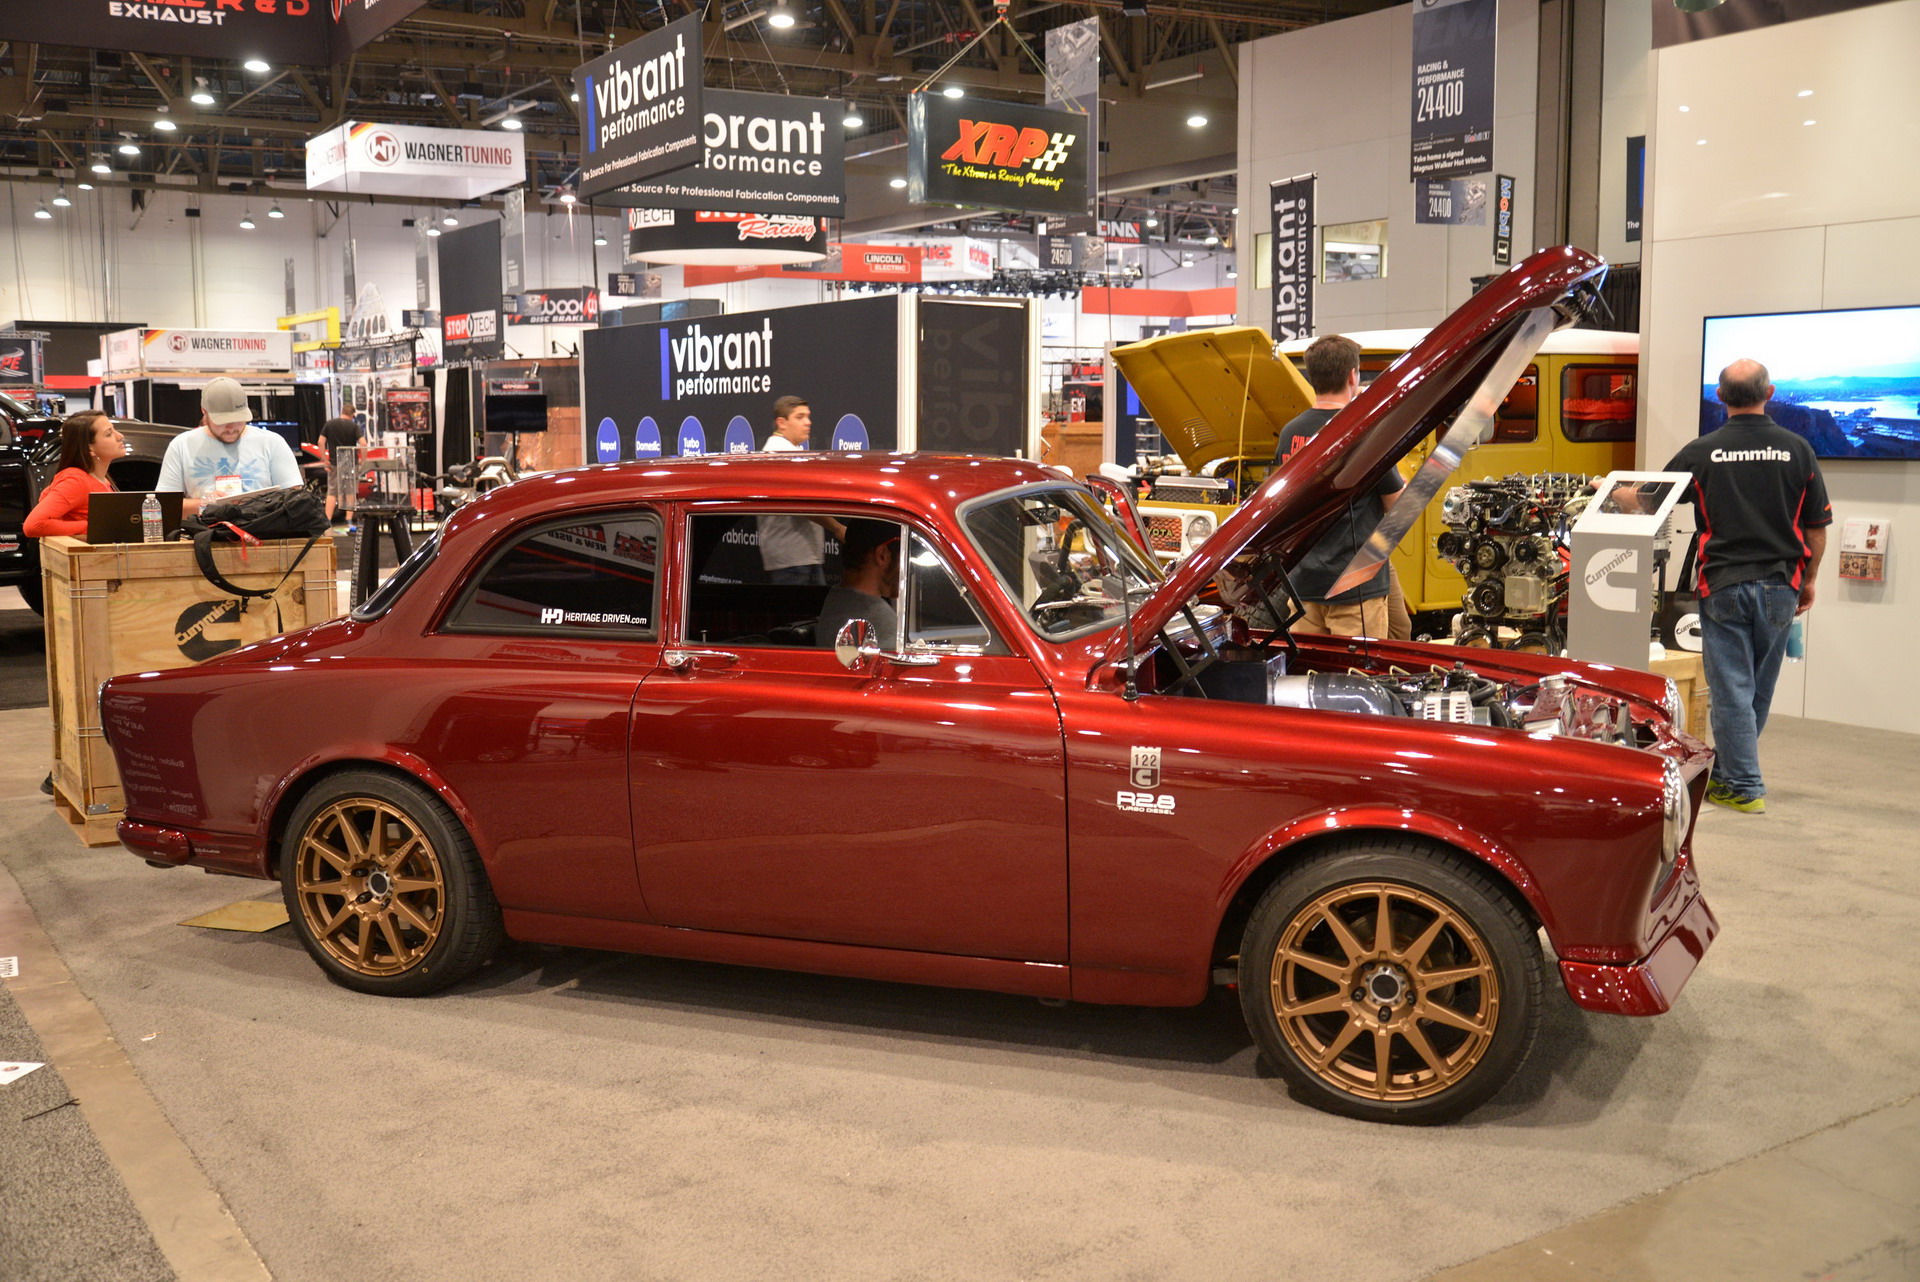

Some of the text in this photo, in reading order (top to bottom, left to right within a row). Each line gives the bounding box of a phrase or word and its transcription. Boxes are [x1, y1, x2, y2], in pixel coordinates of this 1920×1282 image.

[109, 1, 227, 26] EXHAUST
[595, 33, 686, 119] vibrant
[1417, 60, 1449, 75] RACING &
[1417, 68, 1465, 86] PERFORMANCE
[1417, 80, 1464, 122] 24400
[601, 96, 685, 149] performance
[404, 141, 512, 165] WAGNERTUNING
[941, 119, 1049, 168] XRP
[590, 167, 604, 179] Source
[612, 152, 638, 170] Professional
[638, 145, 665, 162] Fabrication
[665, 134, 698, 153] Components
[1413, 155, 1427, 164] Take
[1446, 148, 1464, 159] signed
[1413, 164, 1434, 173] Magnus
[1434, 161, 1453, 169] Walker
[998, 168, 1025, 188] Racing
[631, 183, 663, 194] Source
[665, 184, 680, 194] For
[681, 185, 734, 198] Professional
[735, 188, 784, 201] Fabrication
[785, 191, 840, 206] Components
[1429, 197, 1452, 218] 24400
[1498, 178, 1511, 238] Mobil
[738, 218, 816, 242] Racing
[1627, 221, 1640, 230] The
[866, 254, 902, 264] LINCOLN
[874, 264, 906, 272] ELECTRIC
[1296, 197, 1309, 339] performance
[1274, 198, 1298, 343] vibrant
[446, 315, 495, 337] STOP TECH
[530, 315, 550, 323] DISC
[191, 337, 267, 351] WAGNERTUNING
[671, 317, 773, 373] vibrant
[676, 372, 771, 400] performance
[600, 440, 617, 452] Import
[636, 440, 661, 452] Domestic
[683, 437, 700, 449] Turbo
[730, 441, 749, 453] Exotic
[838, 438, 862, 450] Power
[1710, 446, 1791, 463] Cummins
[1585, 549, 1633, 586] Cummins
[175, 599, 236, 646] Cummins
[564, 612, 601, 623] HERITAGE
[602, 613, 647, 625] DRIVEN.com
[1134, 754, 1157, 767] 122
[1116, 791, 1176, 810] R2.8
[1117, 805, 1175, 816] TURBO DIESEL
